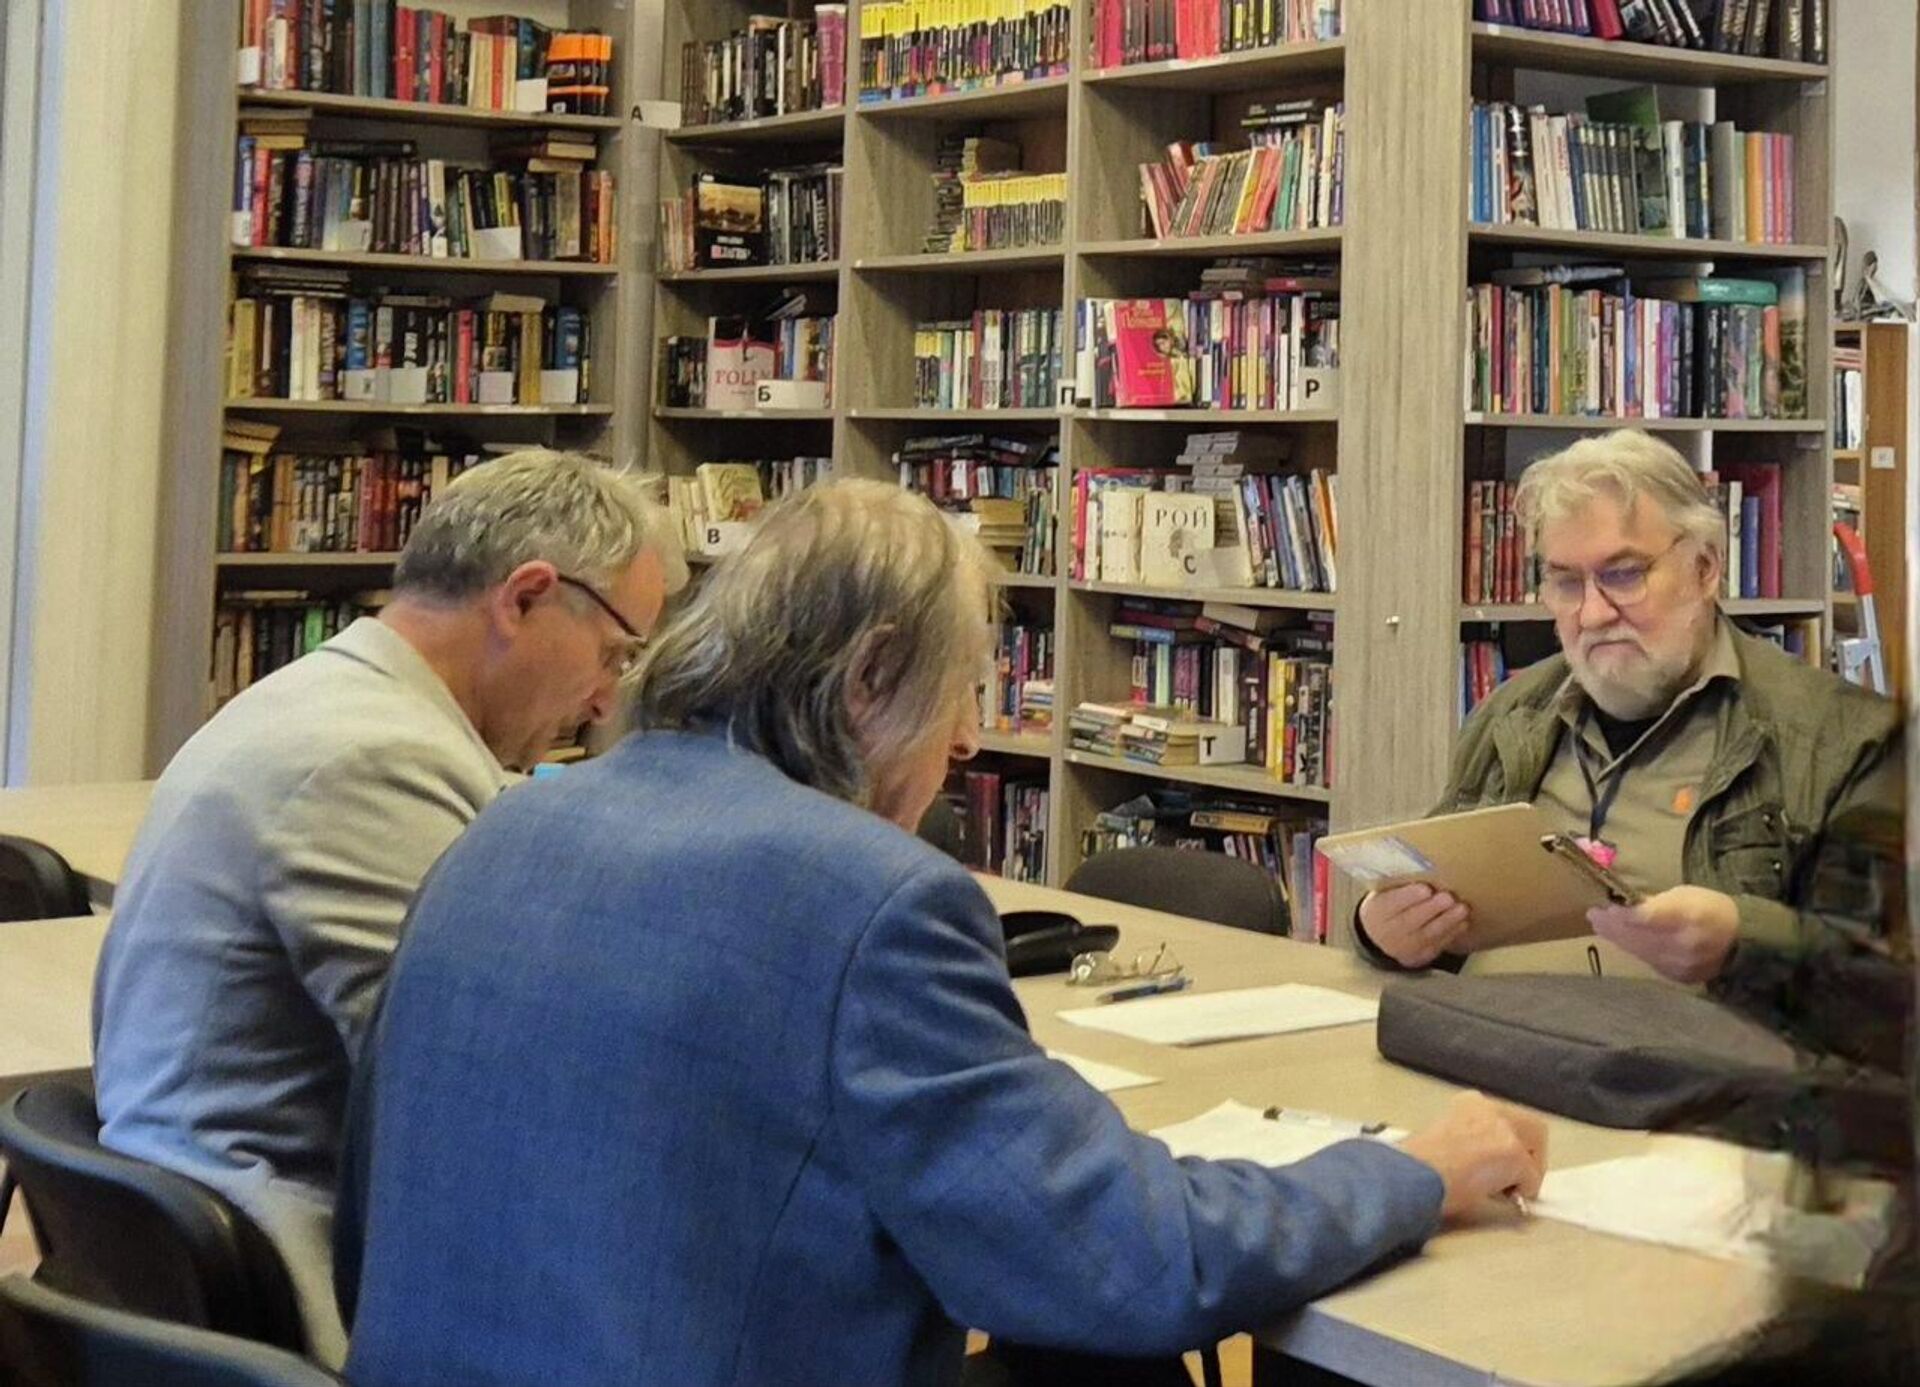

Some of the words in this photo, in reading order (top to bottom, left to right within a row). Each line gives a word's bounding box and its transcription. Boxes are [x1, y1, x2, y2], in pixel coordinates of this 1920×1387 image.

[630, 104, 643, 121] А
[758, 385, 771, 402] Б
[1061, 386, 1076, 404] П
[1305, 379, 1319, 399] Р
[1155, 506, 1207, 529] РОЙ
[707, 528, 721, 544] В
[1183, 554, 1197, 574] С
[1202, 736, 1217, 756] Т
